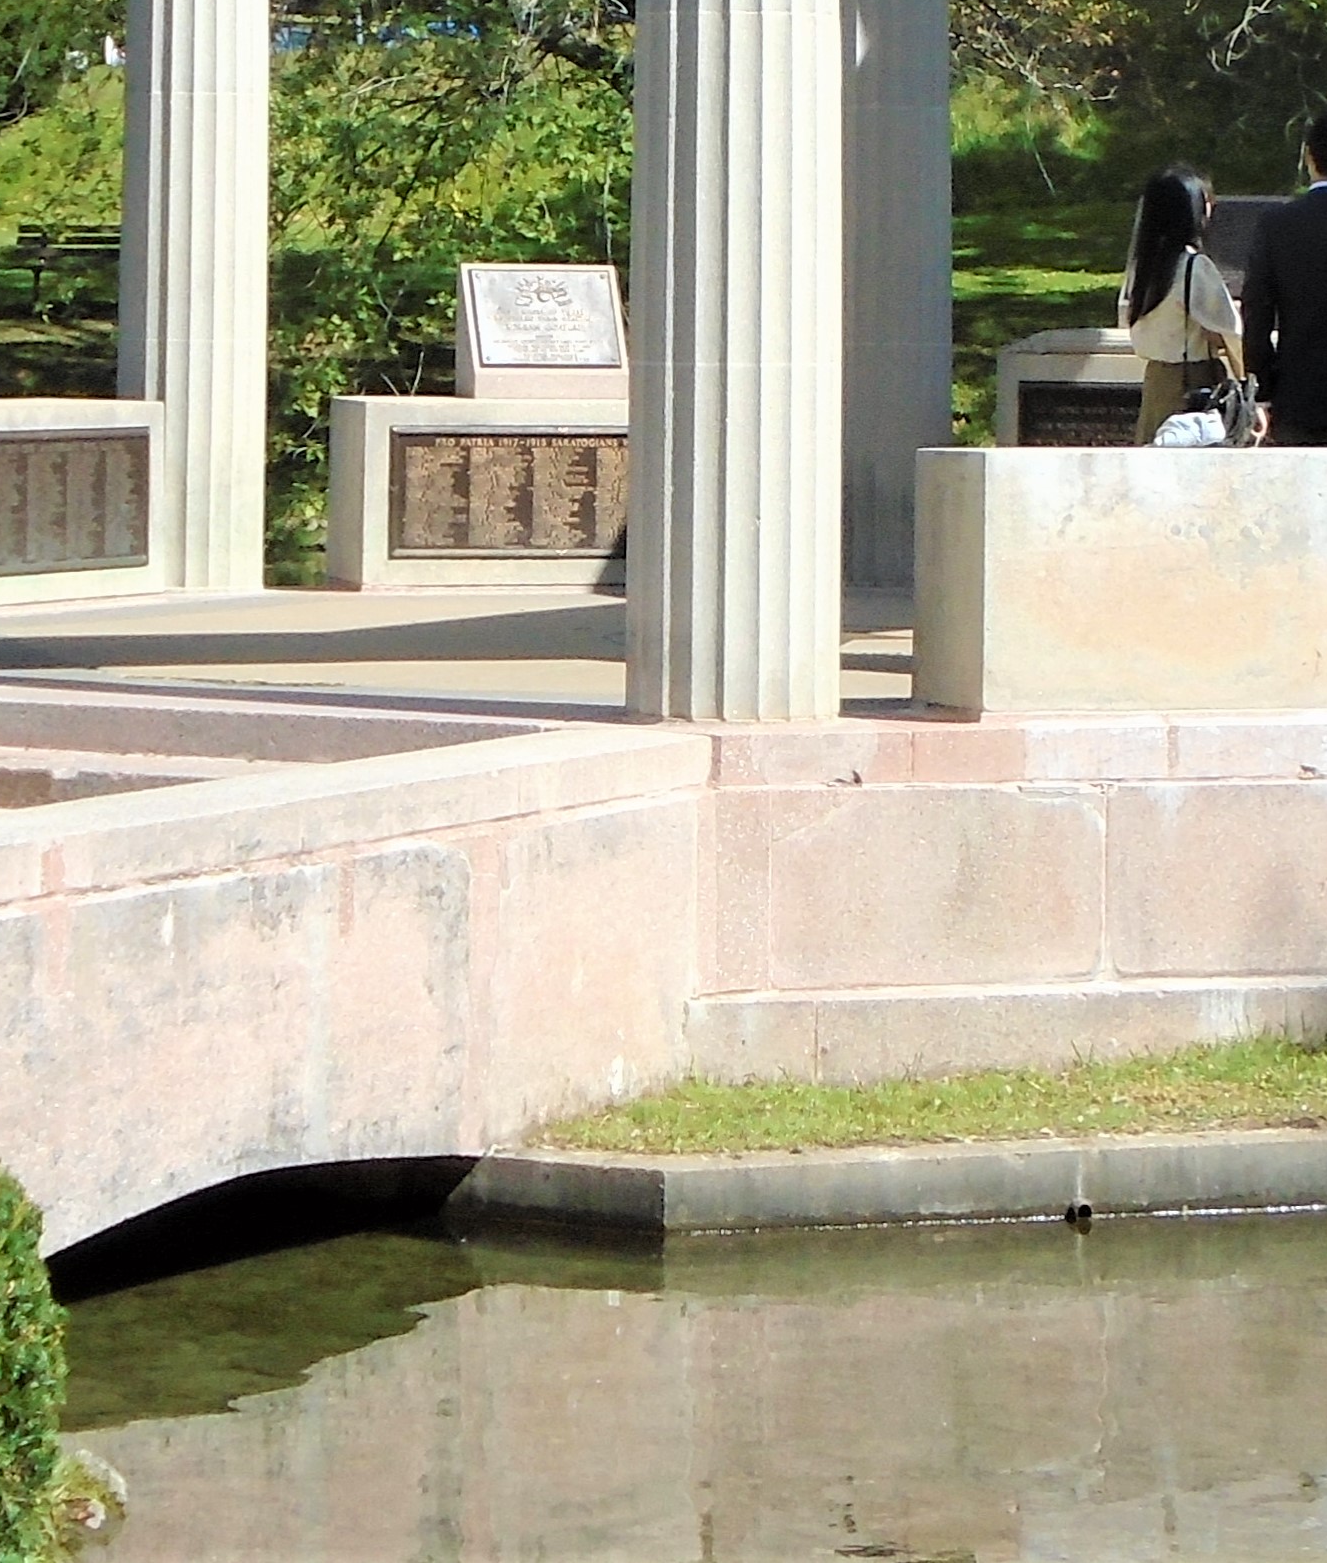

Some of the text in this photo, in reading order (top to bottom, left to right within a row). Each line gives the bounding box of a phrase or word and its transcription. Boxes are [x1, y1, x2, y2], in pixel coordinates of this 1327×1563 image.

[435, 437, 456, 448] PRO
[460, 437, 495, 448] PATRIA
[551, 437, 618, 448] SARATOGIANS
